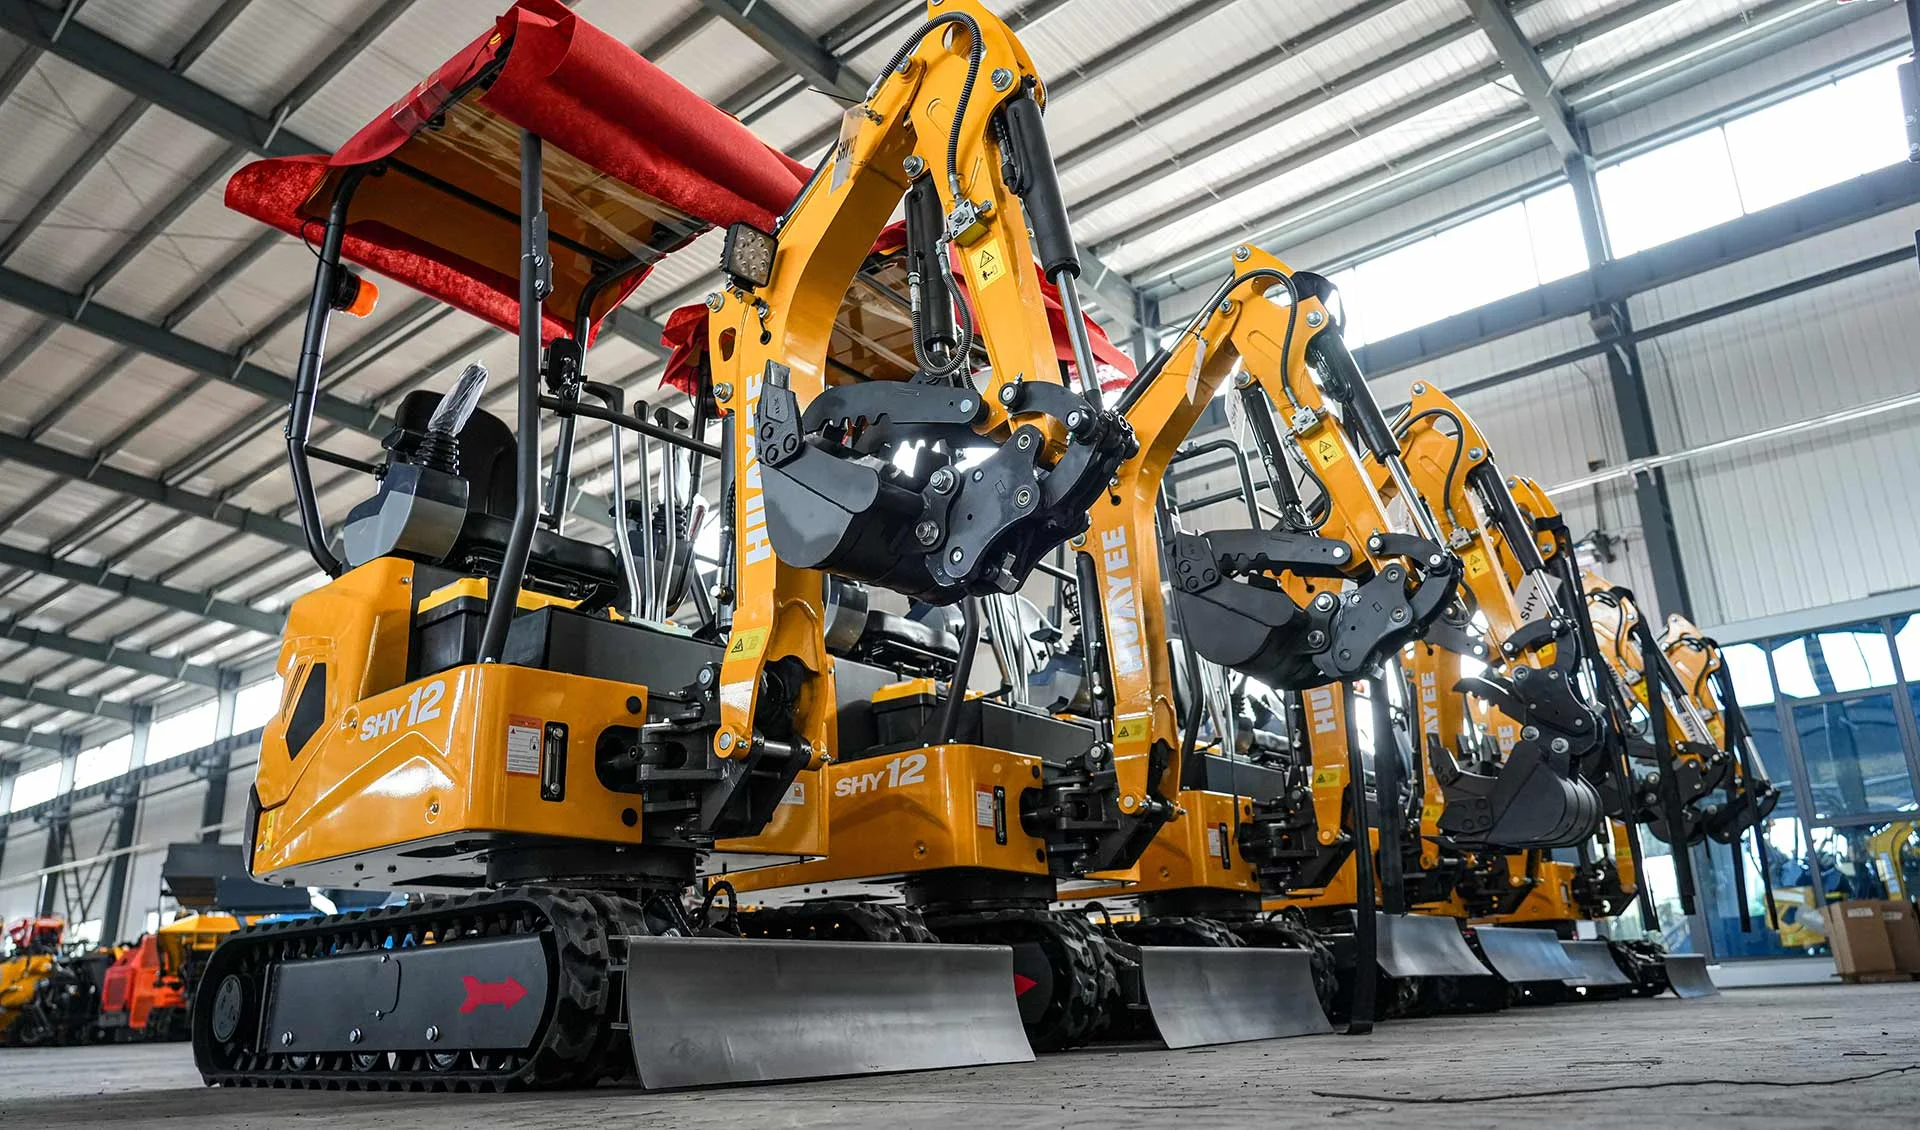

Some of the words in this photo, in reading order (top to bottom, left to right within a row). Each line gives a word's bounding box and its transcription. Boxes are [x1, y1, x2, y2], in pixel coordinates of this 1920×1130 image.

[746, 372, 772, 566] HUAE
[1101, 525, 1143, 676] HUAYEE
[1310, 685, 1336, 734] HU
[1421, 671, 1440, 775] AYEE
